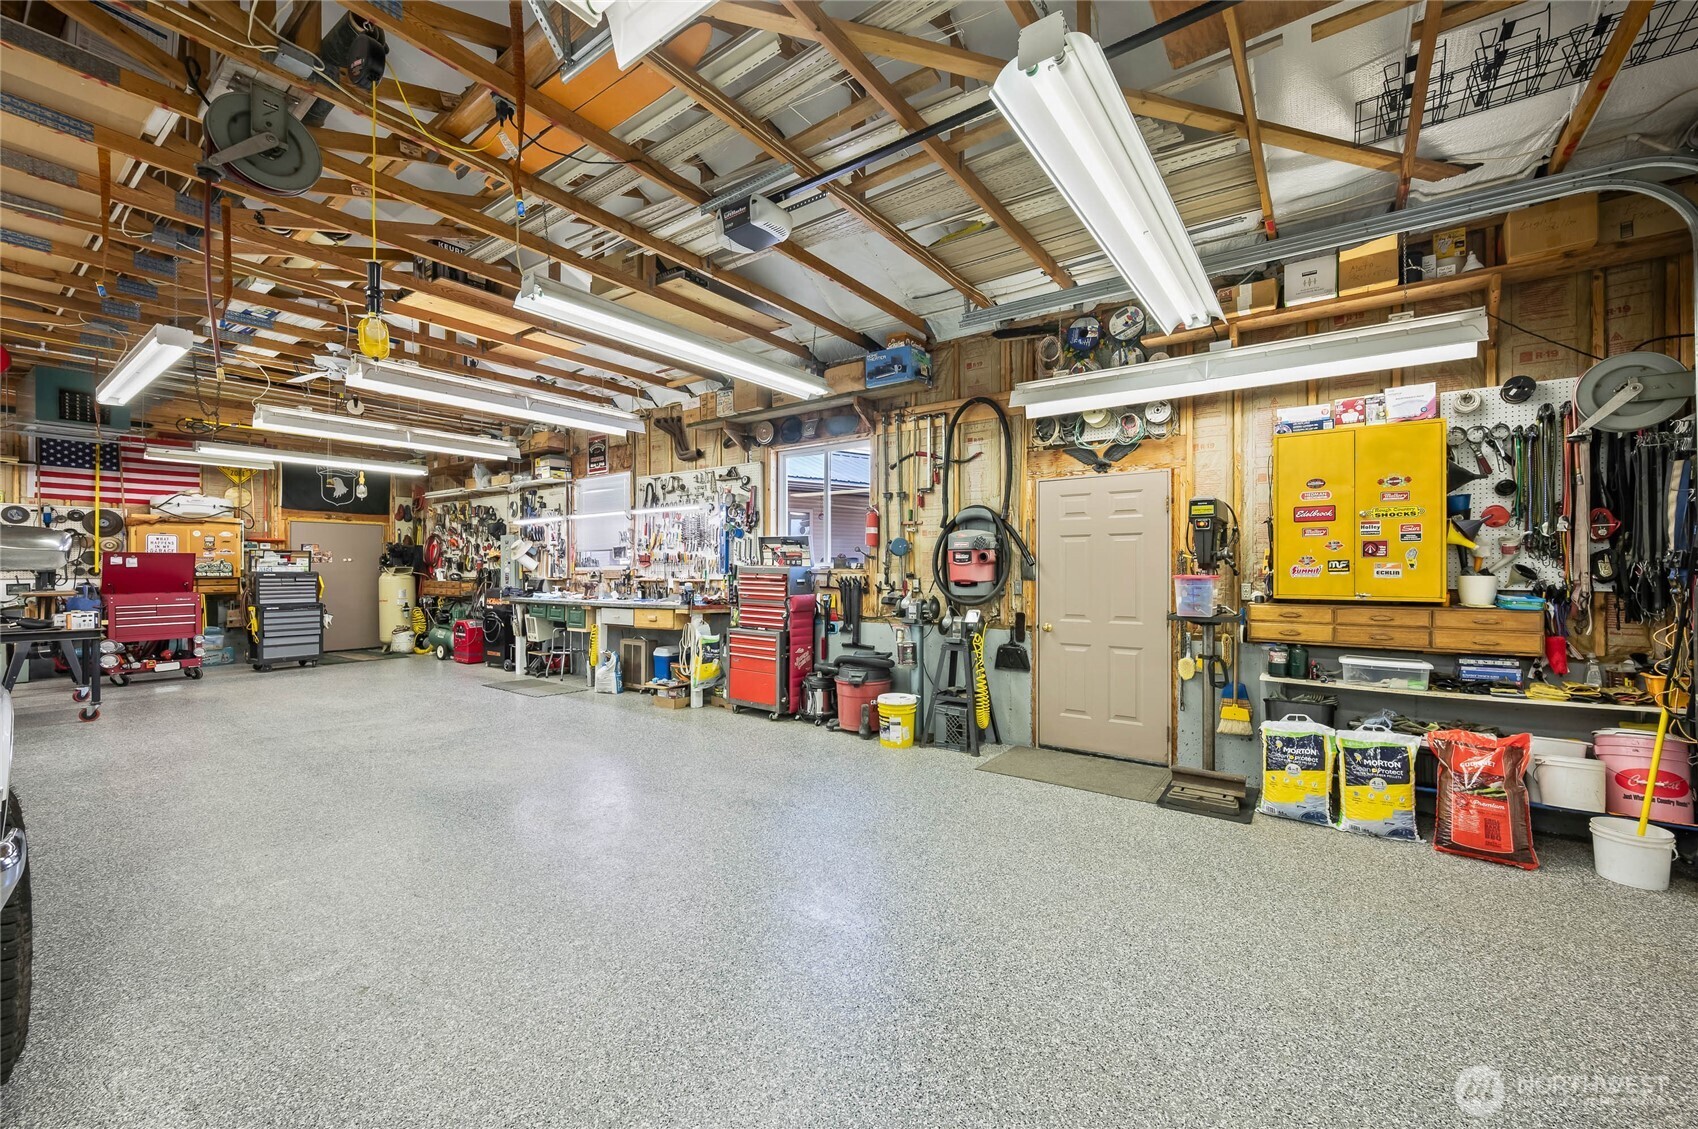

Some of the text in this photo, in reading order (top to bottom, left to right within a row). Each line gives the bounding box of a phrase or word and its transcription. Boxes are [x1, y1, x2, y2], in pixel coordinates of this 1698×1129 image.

[437, 241, 464, 254] KEURI
[1295, 509, 1333, 518] Edelbrock
[1283, 747, 1317, 756] MORTON
[1363, 759, 1402, 769] MORTON
[1377, 768, 1404, 776] Protect
